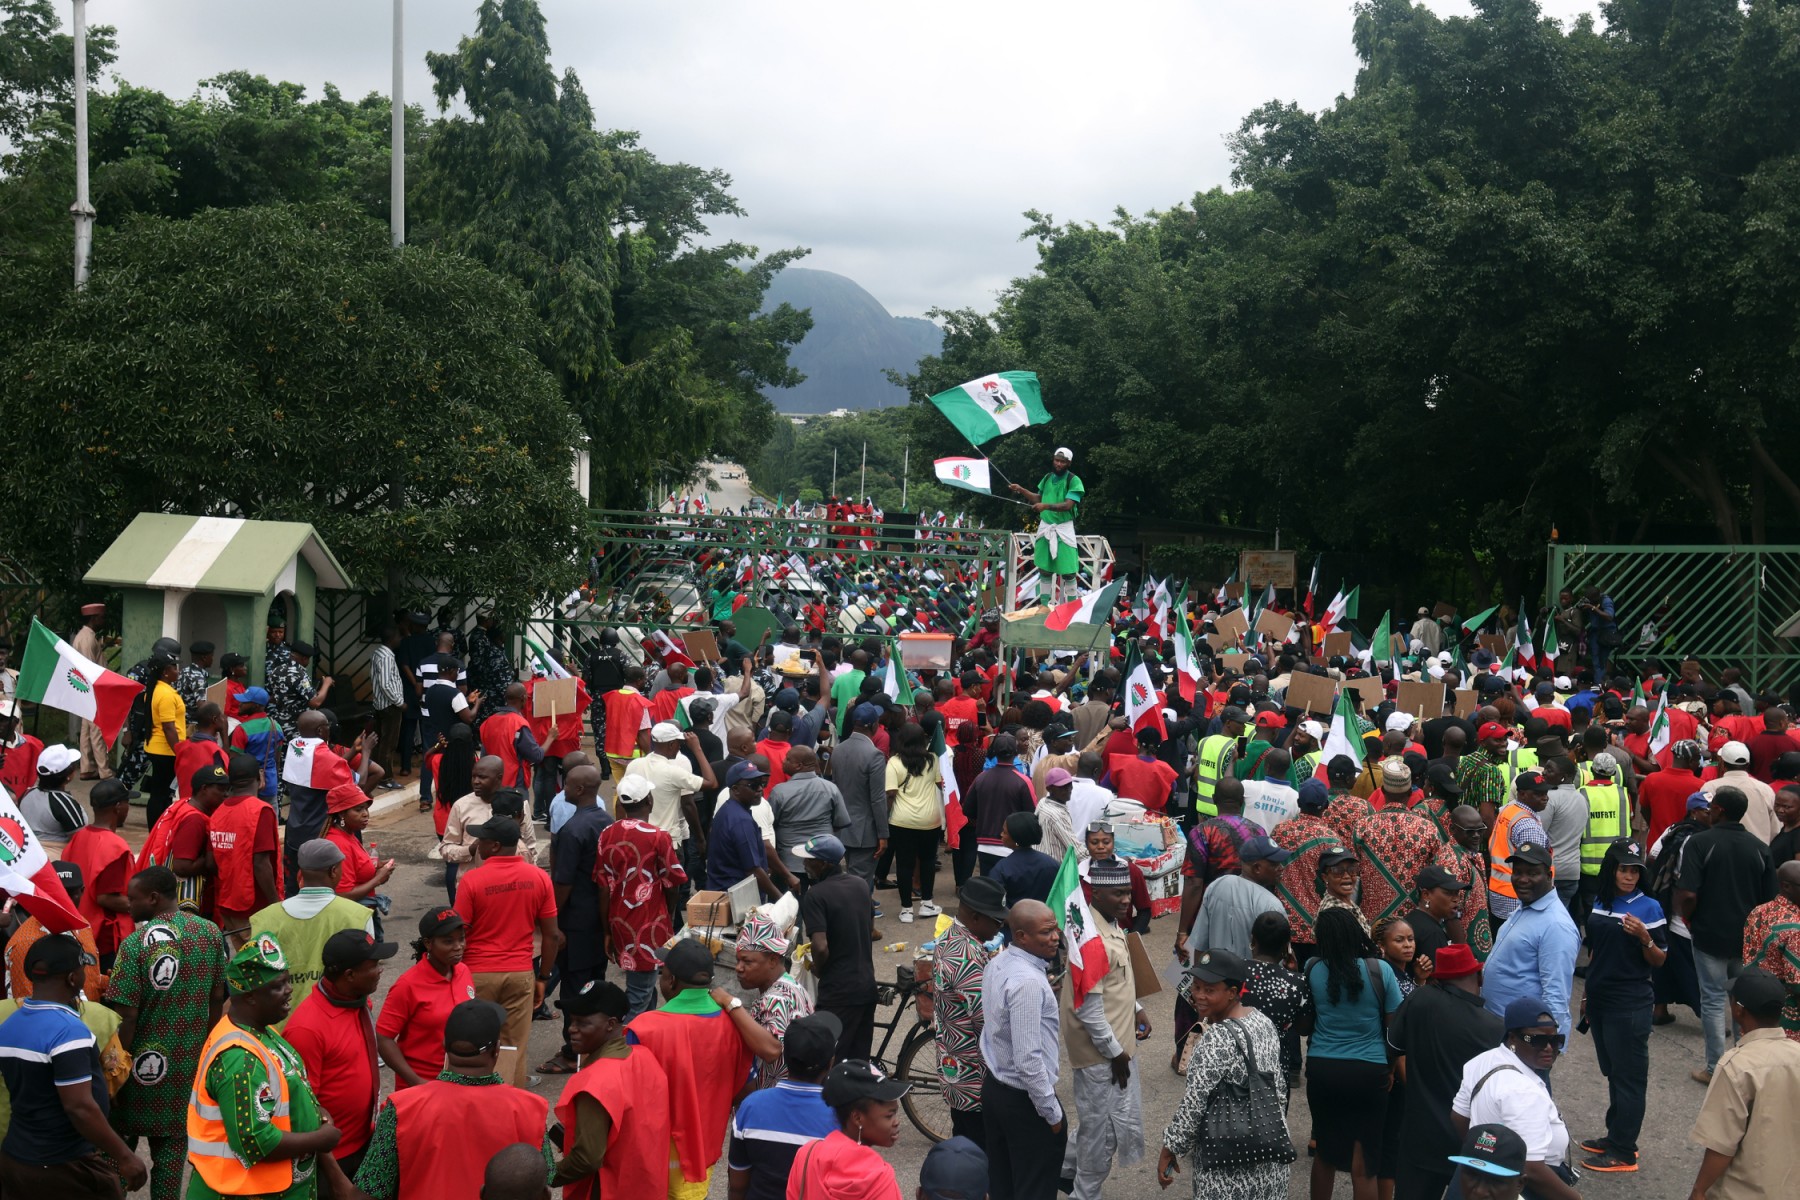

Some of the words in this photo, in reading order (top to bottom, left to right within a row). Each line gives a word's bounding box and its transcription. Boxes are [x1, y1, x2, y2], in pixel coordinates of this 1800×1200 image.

[1260, 794, 1285, 806] Abuja
[1254, 801, 1288, 816] SHIFT
[1590, 811, 1616, 819] NUFBTE
[517, 880, 535, 891] UNION
